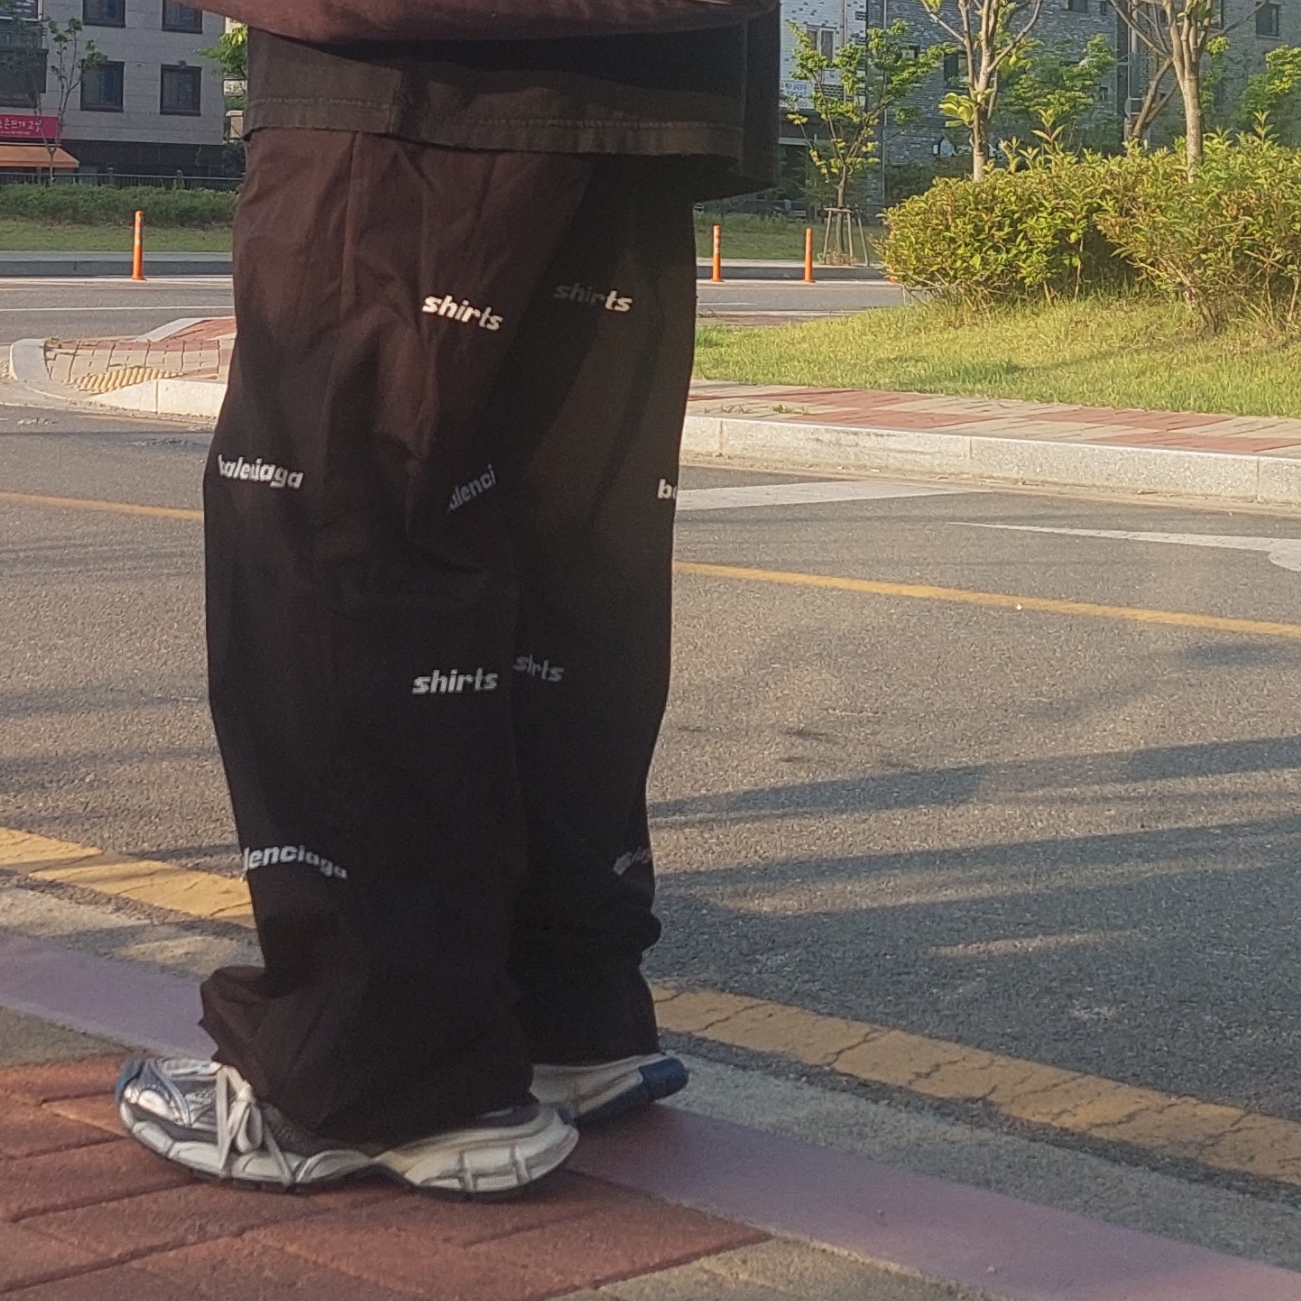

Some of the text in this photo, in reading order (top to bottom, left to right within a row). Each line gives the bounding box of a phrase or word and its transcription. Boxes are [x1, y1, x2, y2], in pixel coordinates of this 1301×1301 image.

[553, 281, 633, 312] shirts
[421, 294, 503, 331] shirts
[412, 667, 498, 695] shirts
